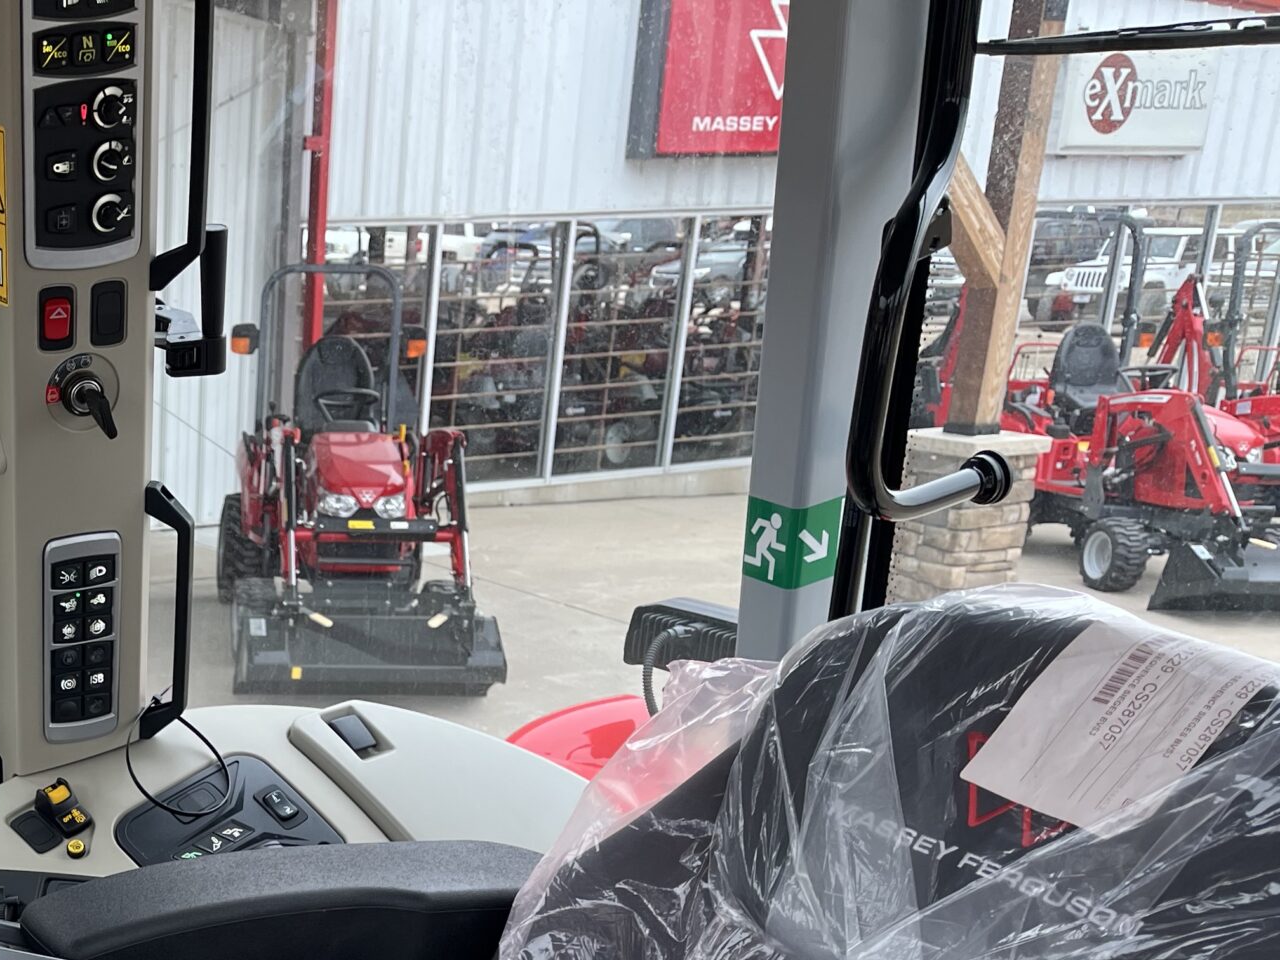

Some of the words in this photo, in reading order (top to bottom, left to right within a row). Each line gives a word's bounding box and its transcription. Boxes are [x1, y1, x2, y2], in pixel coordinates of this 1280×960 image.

[82, 35, 93, 49] N
[692, 116, 778, 132] MASSEY
[90, 673, 104, 684] ISB
[1098, 681, 1158, 750] CS287057
[1175, 707, 1233, 772] CS287057
